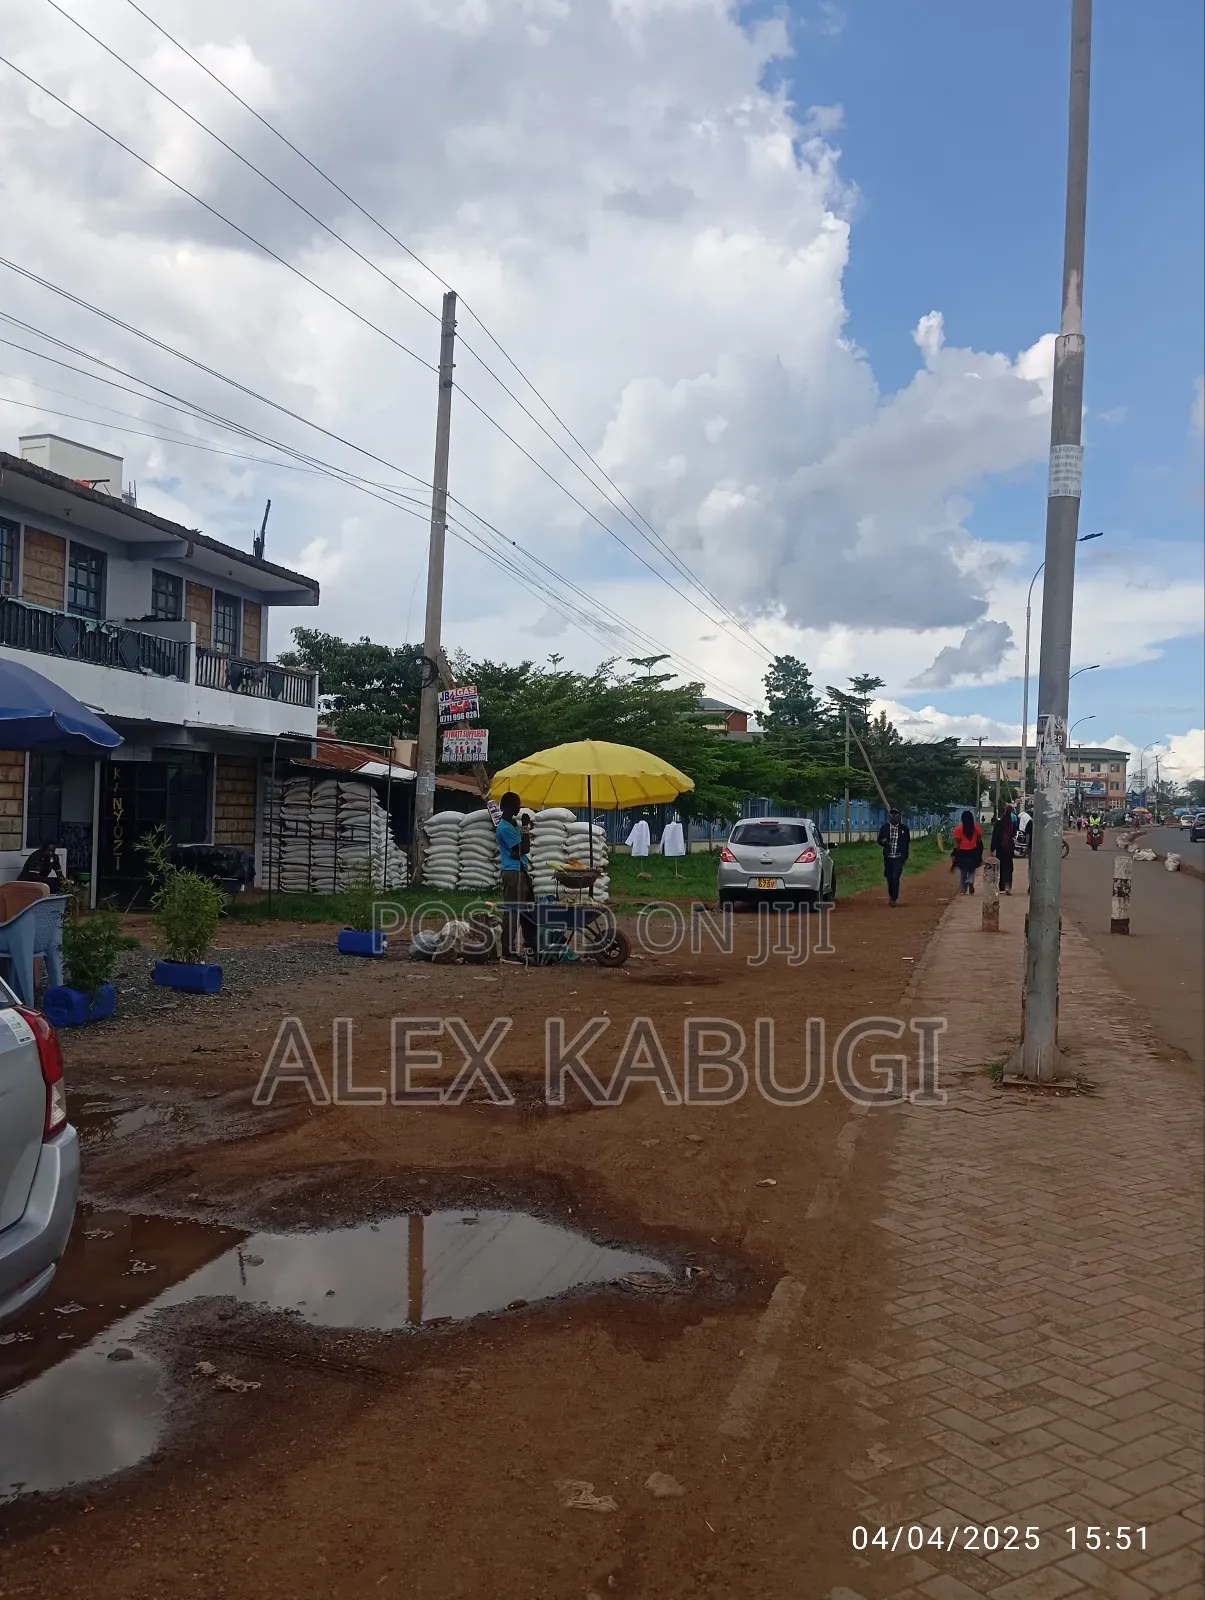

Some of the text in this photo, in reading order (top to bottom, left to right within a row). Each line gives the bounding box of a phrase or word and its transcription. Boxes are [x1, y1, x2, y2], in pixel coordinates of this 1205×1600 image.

[440, 692, 450, 701] JB
[457, 686, 475, 696] GAS
[463, 729, 487, 737] SUPPLIERS
[113, 766, 124, 870] KINYOZI
